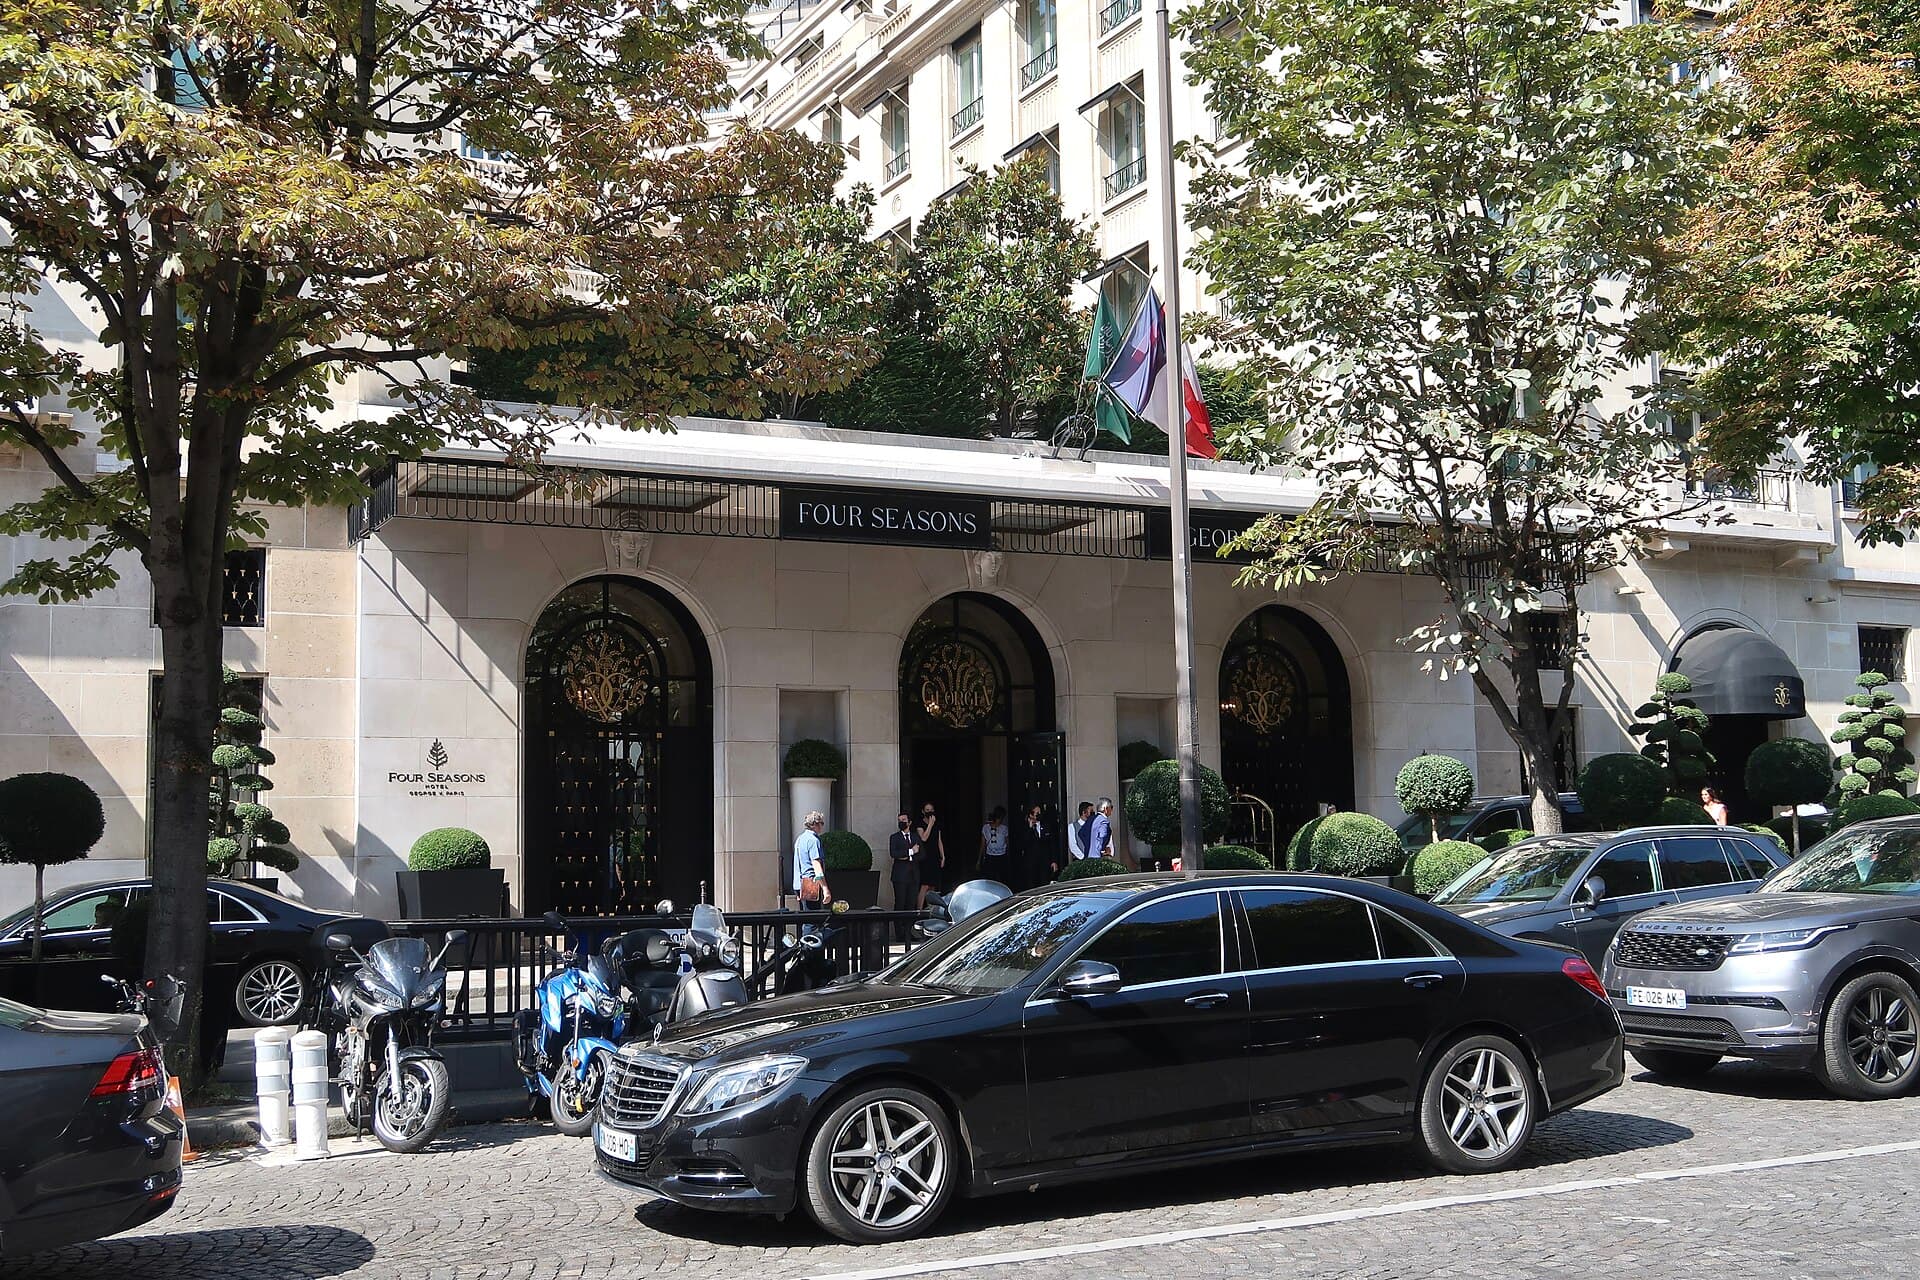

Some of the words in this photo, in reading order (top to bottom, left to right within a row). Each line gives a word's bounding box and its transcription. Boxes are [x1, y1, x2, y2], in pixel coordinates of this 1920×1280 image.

[799, 502, 864, 528] FOUR
[871, 507, 977, 534] SEASONS
[388, 772, 424, 783] FOUR
[427, 772, 486, 783] SEASONS
